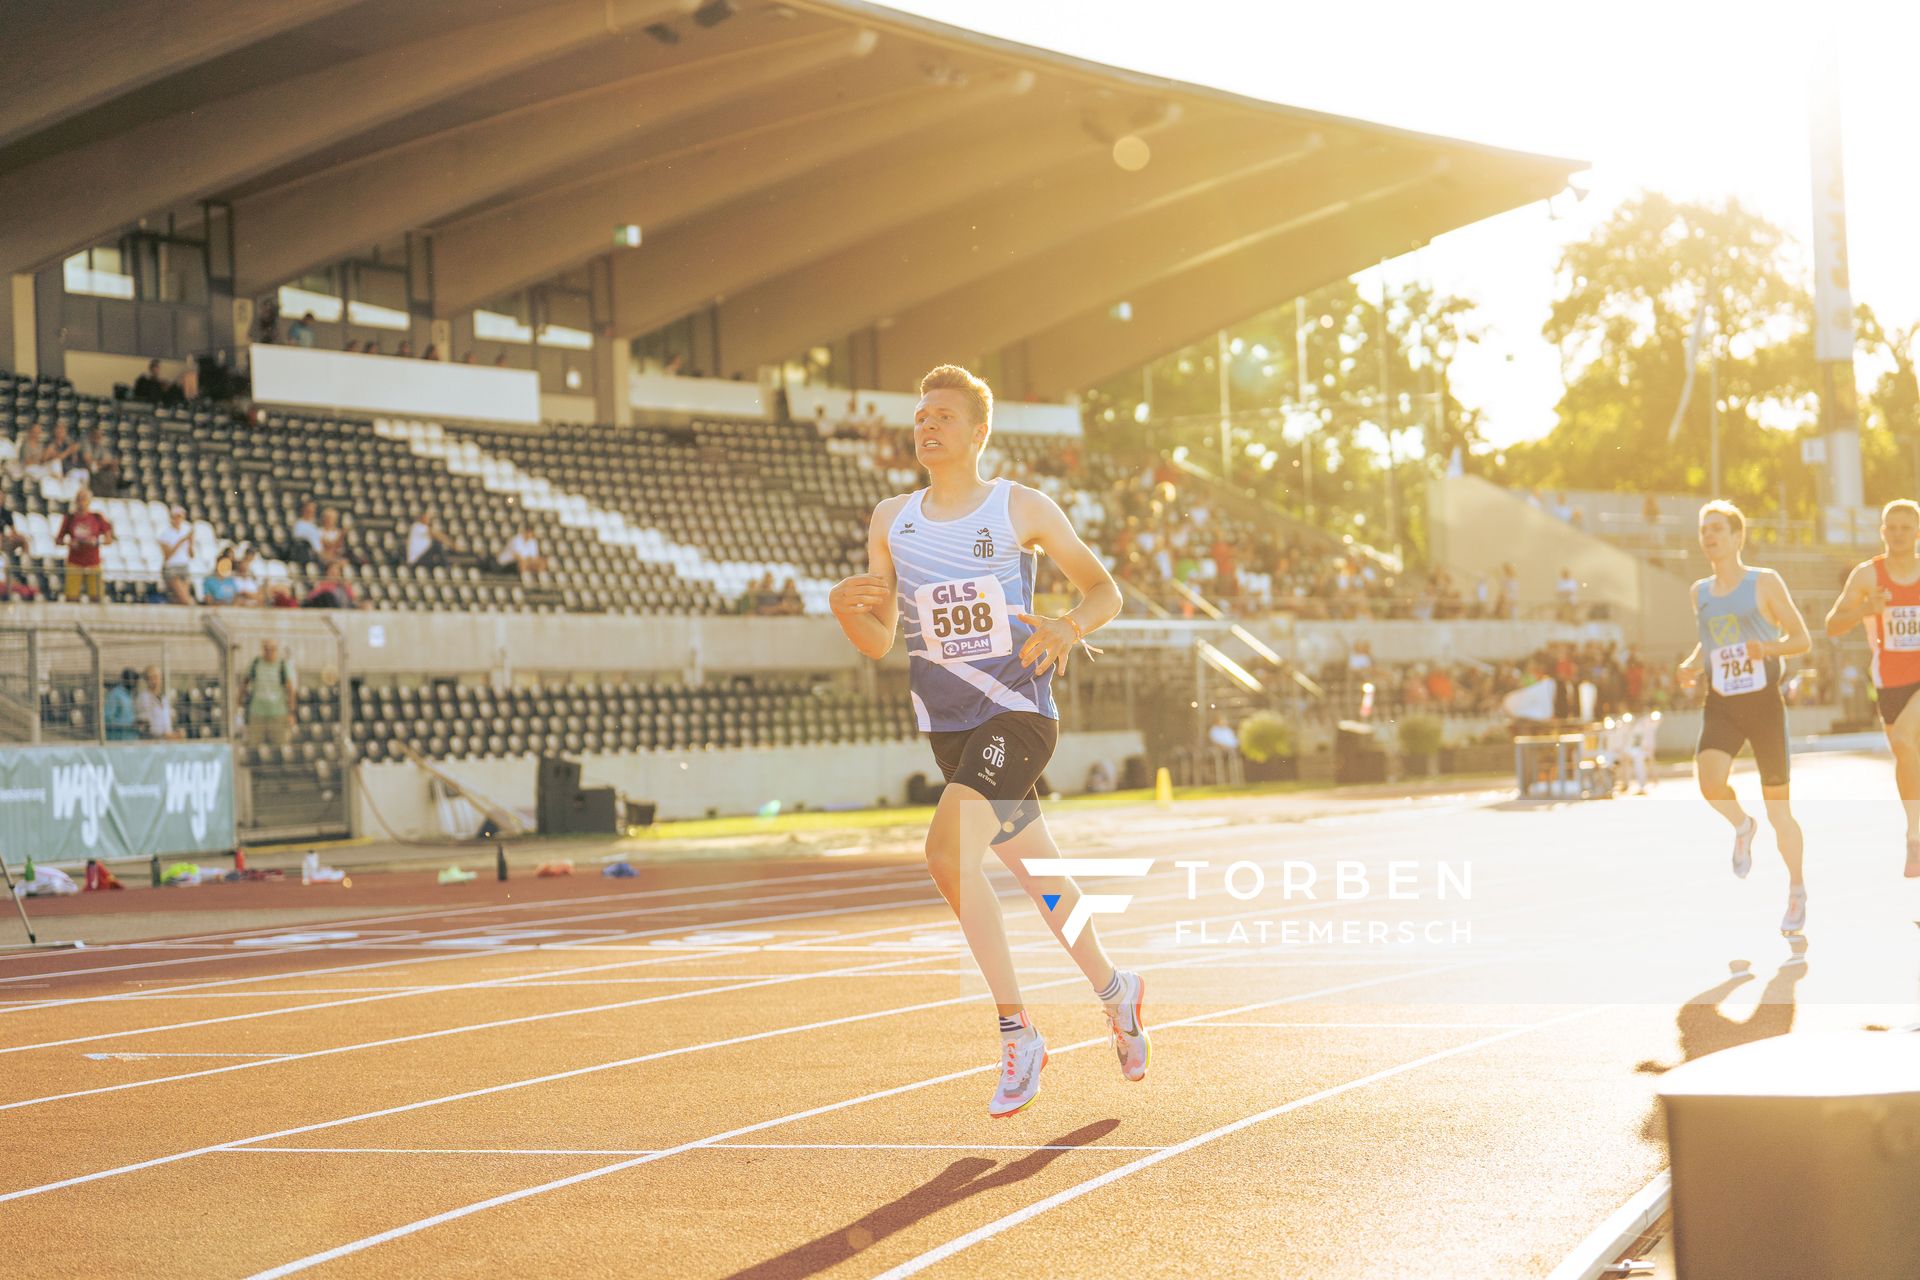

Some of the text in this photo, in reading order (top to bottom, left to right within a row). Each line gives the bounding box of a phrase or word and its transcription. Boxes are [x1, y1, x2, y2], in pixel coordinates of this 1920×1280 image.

[973, 539, 994, 559] OTB
[932, 602, 993, 638] 598
[1886, 620, 1920, 636] 108
[961, 638, 990, 650] PLAN
[1720, 659, 1754, 680] 784
[982, 743, 1005, 768] OTB
